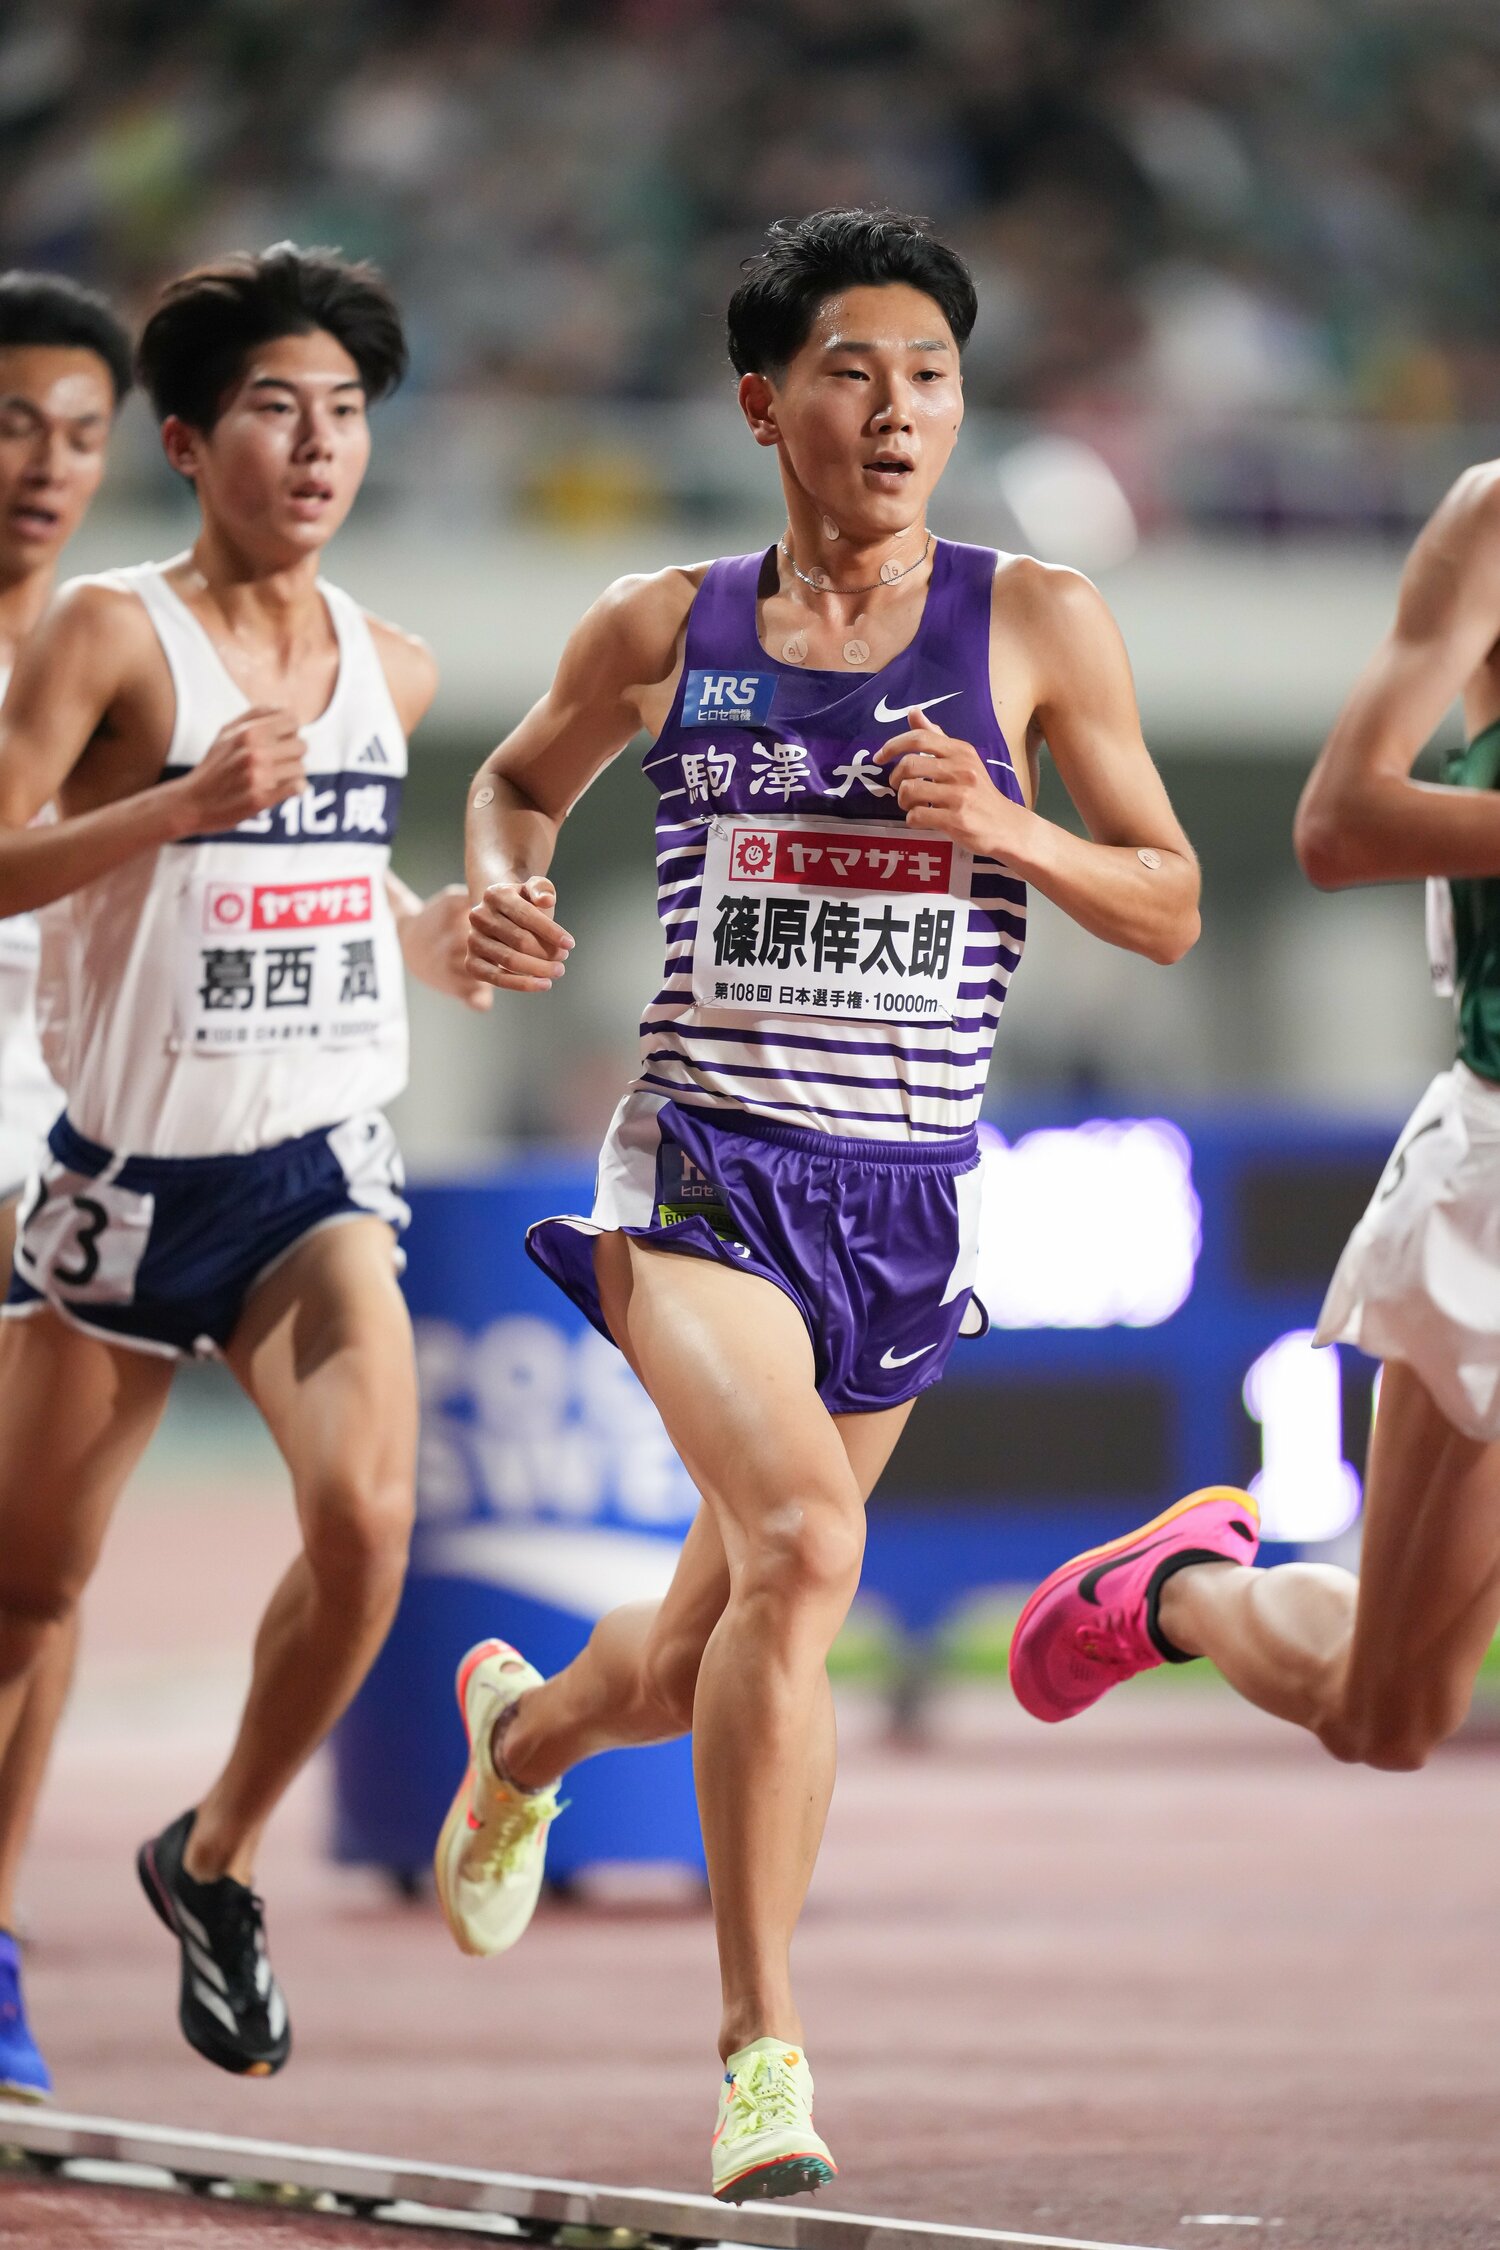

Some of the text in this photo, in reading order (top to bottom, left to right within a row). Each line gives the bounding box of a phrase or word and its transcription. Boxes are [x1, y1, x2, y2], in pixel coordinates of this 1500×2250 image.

[699, 675, 760, 706] HRS
[697, 709, 752, 722] ヒロセ電機
[680, 740, 936, 805] 駒澤大
[786, 842, 943, 882] ヤマザキ
[258, 884, 370, 924] ヤマザキ
[712, 894, 956, 981] 篠原倖太朗
[197, 943, 317, 1013] 葛西
[714, 982, 772, 1003] 第108回
[680, 1185, 718, 1197] ヒロセ
